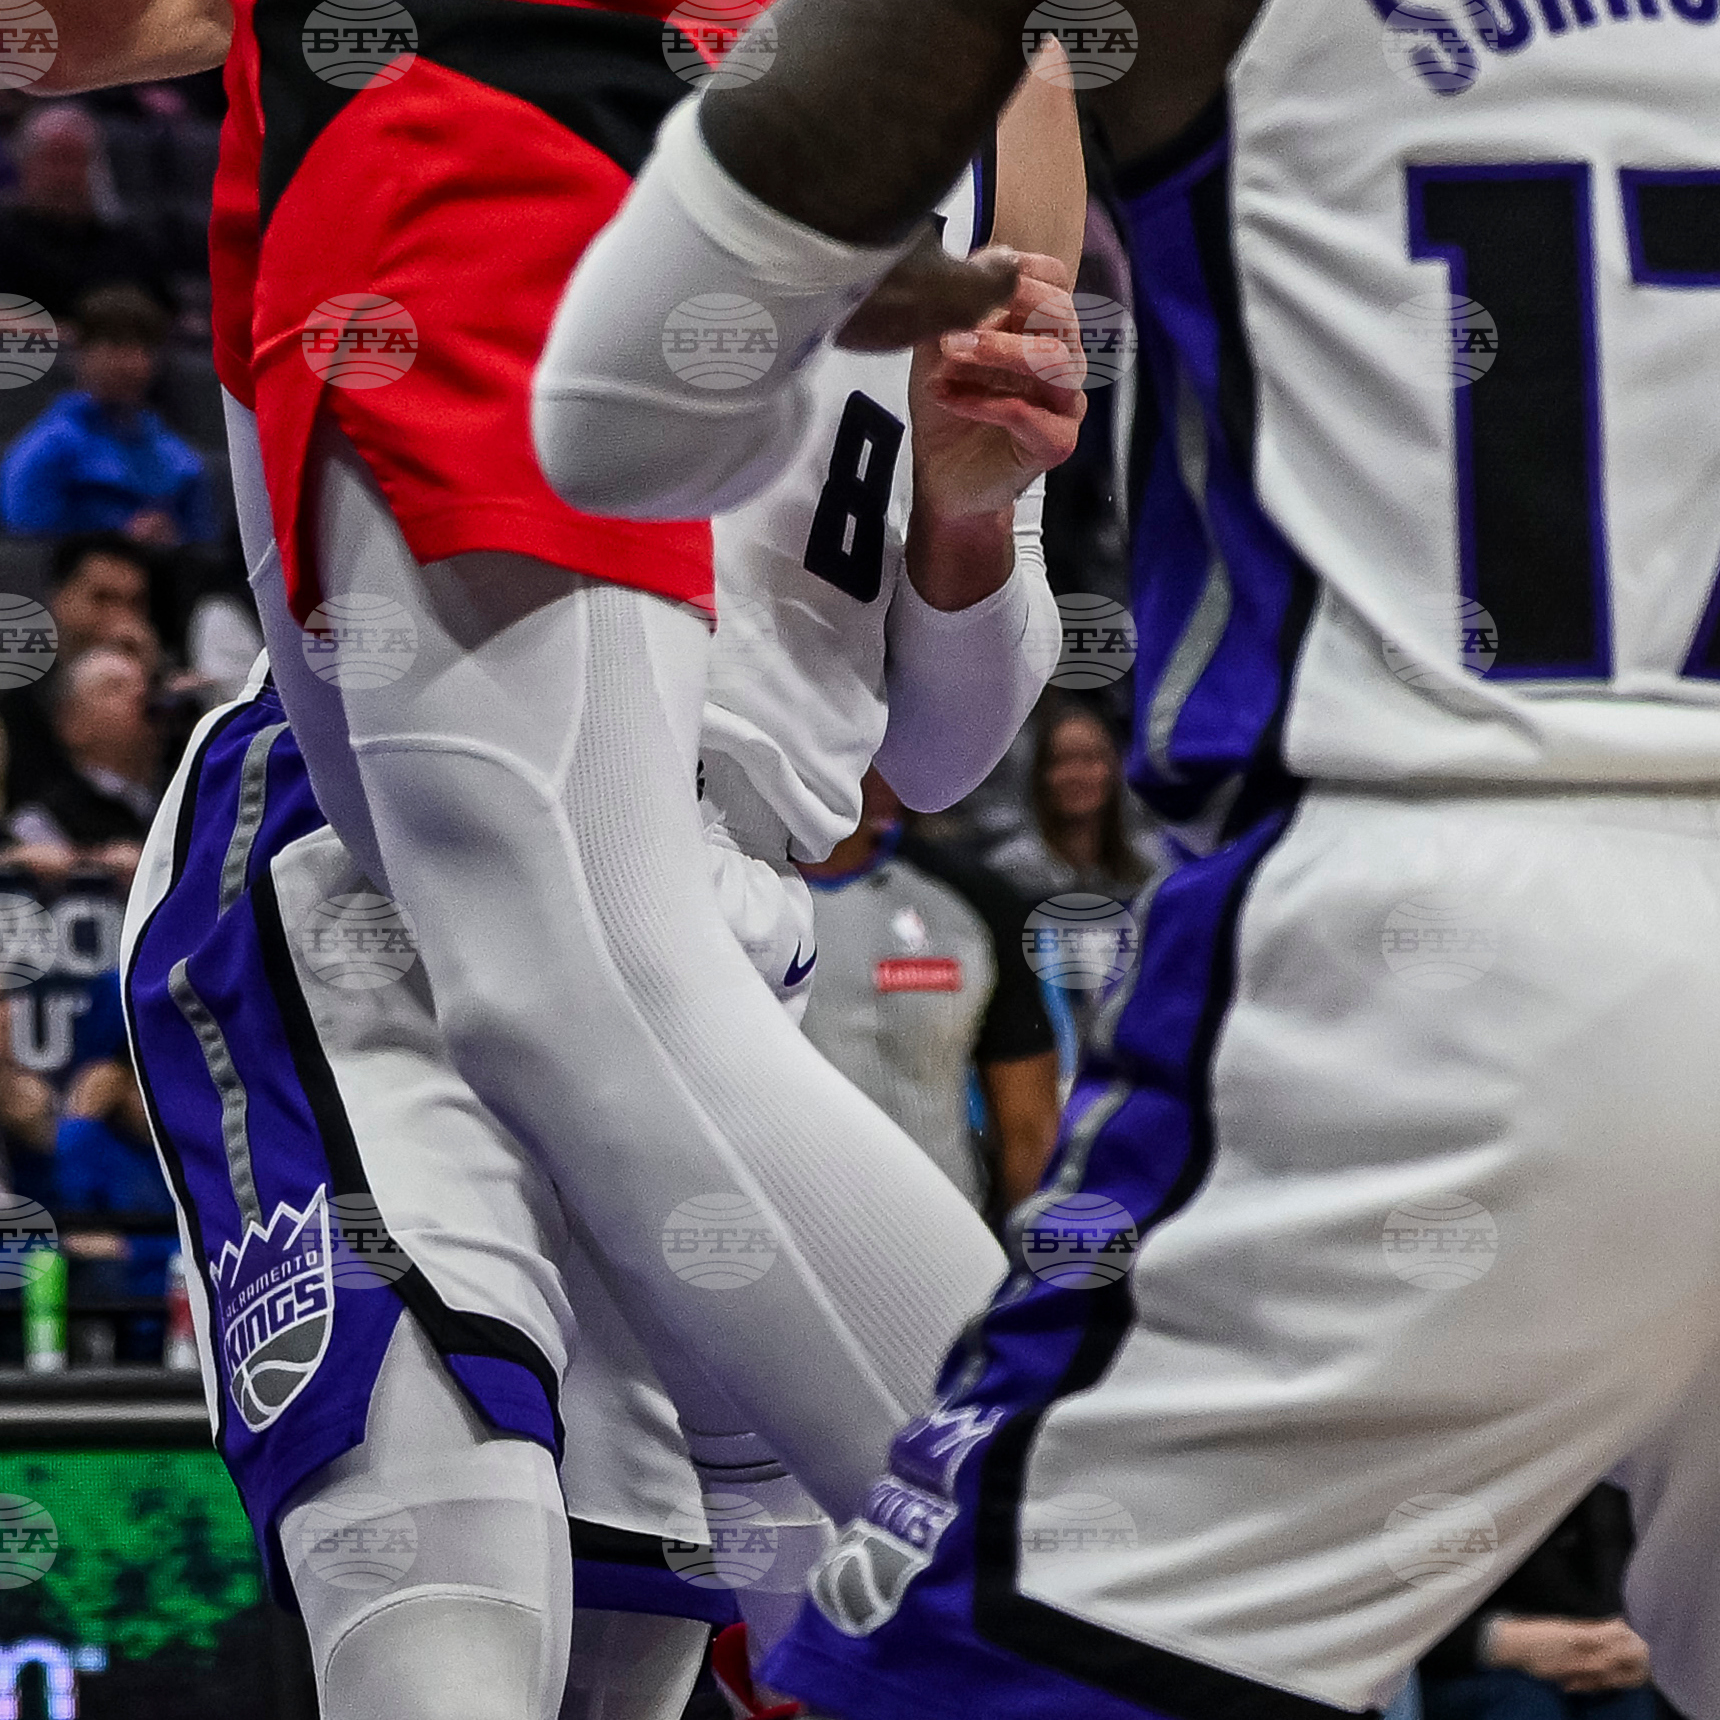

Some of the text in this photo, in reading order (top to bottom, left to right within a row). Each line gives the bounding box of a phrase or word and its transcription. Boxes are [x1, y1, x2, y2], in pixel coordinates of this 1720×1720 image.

[803, 389, 906, 604] 8
[224, 1249, 318, 1320] ACRAMENTO
[226, 1275, 329, 1375] KINGS
